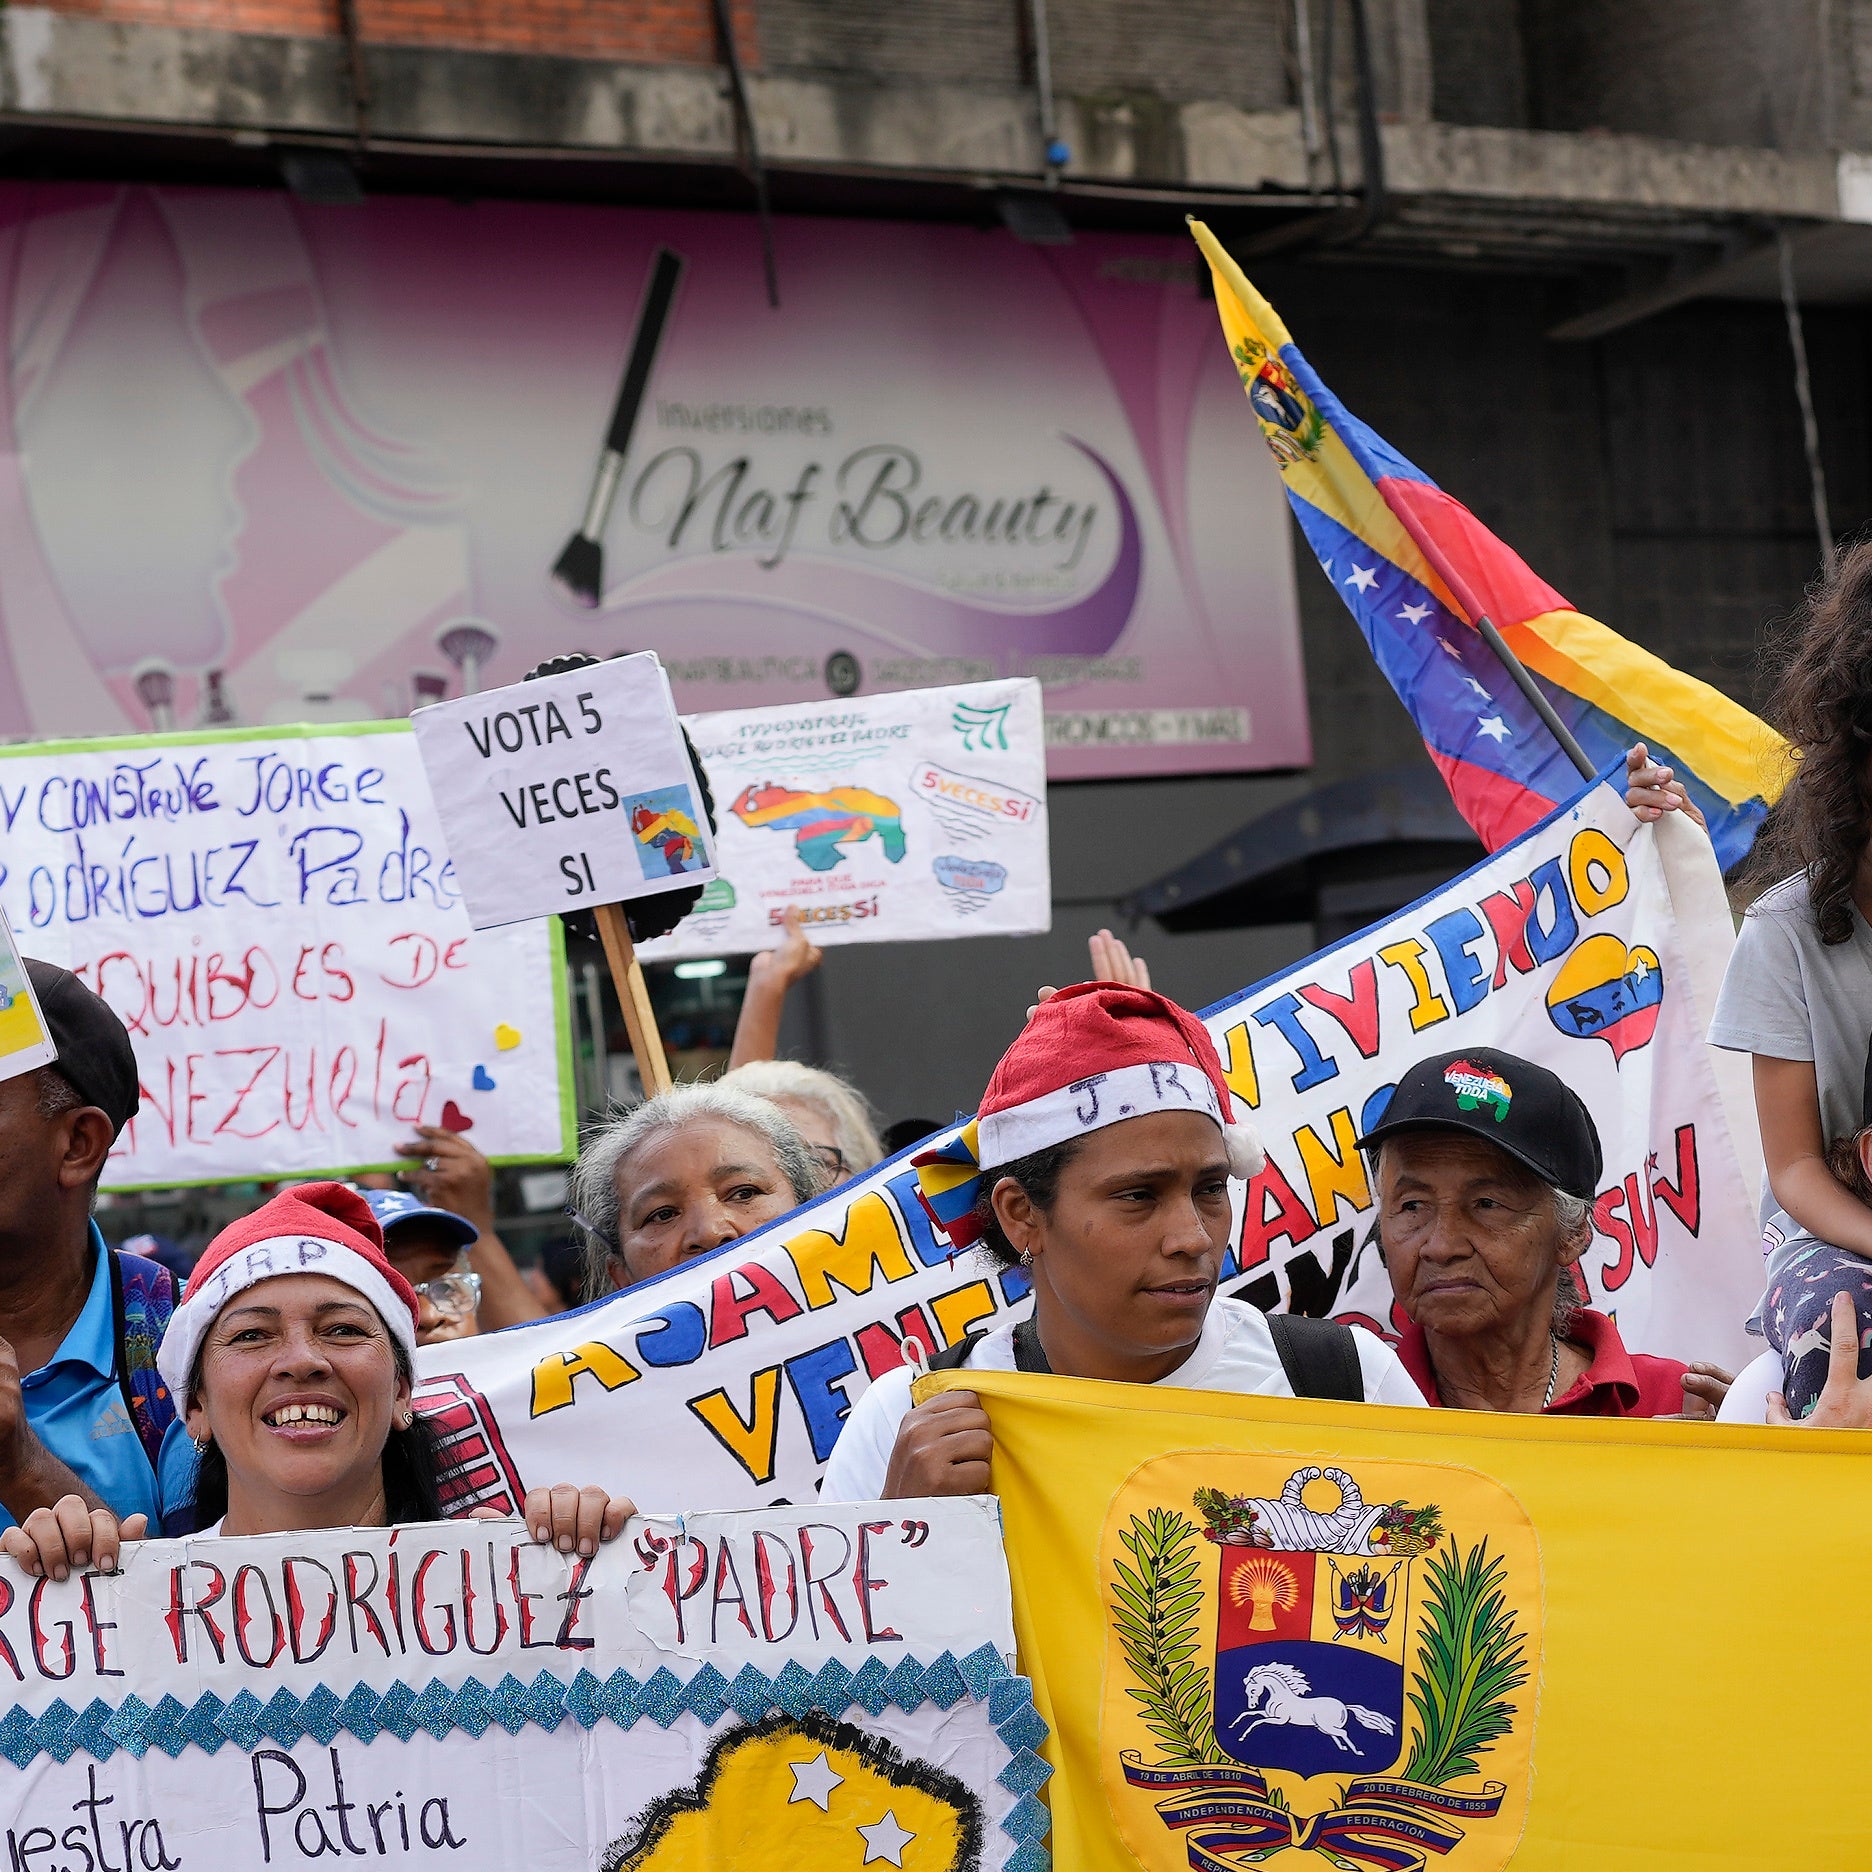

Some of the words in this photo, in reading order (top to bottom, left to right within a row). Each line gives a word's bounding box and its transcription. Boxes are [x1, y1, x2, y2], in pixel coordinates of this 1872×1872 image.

[831, 444, 1097, 570] Beauty
[465, 702, 571, 758] VOTA
[576, 692, 602, 734] 5
[922, 771, 939, 789] 5
[500, 768, 618, 828] VECES
[559, 852, 595, 895] SI
[1444, 1070, 1504, 1093] VENEZUELA
[1455, 1083, 1489, 1100] TODA
[166, 1530, 596, 1668] RODRÍGUEZ
[1139, 1771, 1150, 1782] 19
[1153, 1772, 1168, 1783] DE
[1171, 1771, 1201, 1782] ABRIL
[1202, 1769, 1214, 1779] DE
[1219, 1771, 1242, 1781] 1810
[251, 1745, 467, 1864] Patria
[1178, 1805, 1274, 1820] INDEPENDENCIA
[1363, 1783, 1376, 1793] 20
[1378, 1784, 1393, 1794] DE
[1395, 1785, 1446, 1806] FEBRERO
[1446, 1799, 1462, 1810] DE
[1463, 1801, 1487, 1811] 1859
